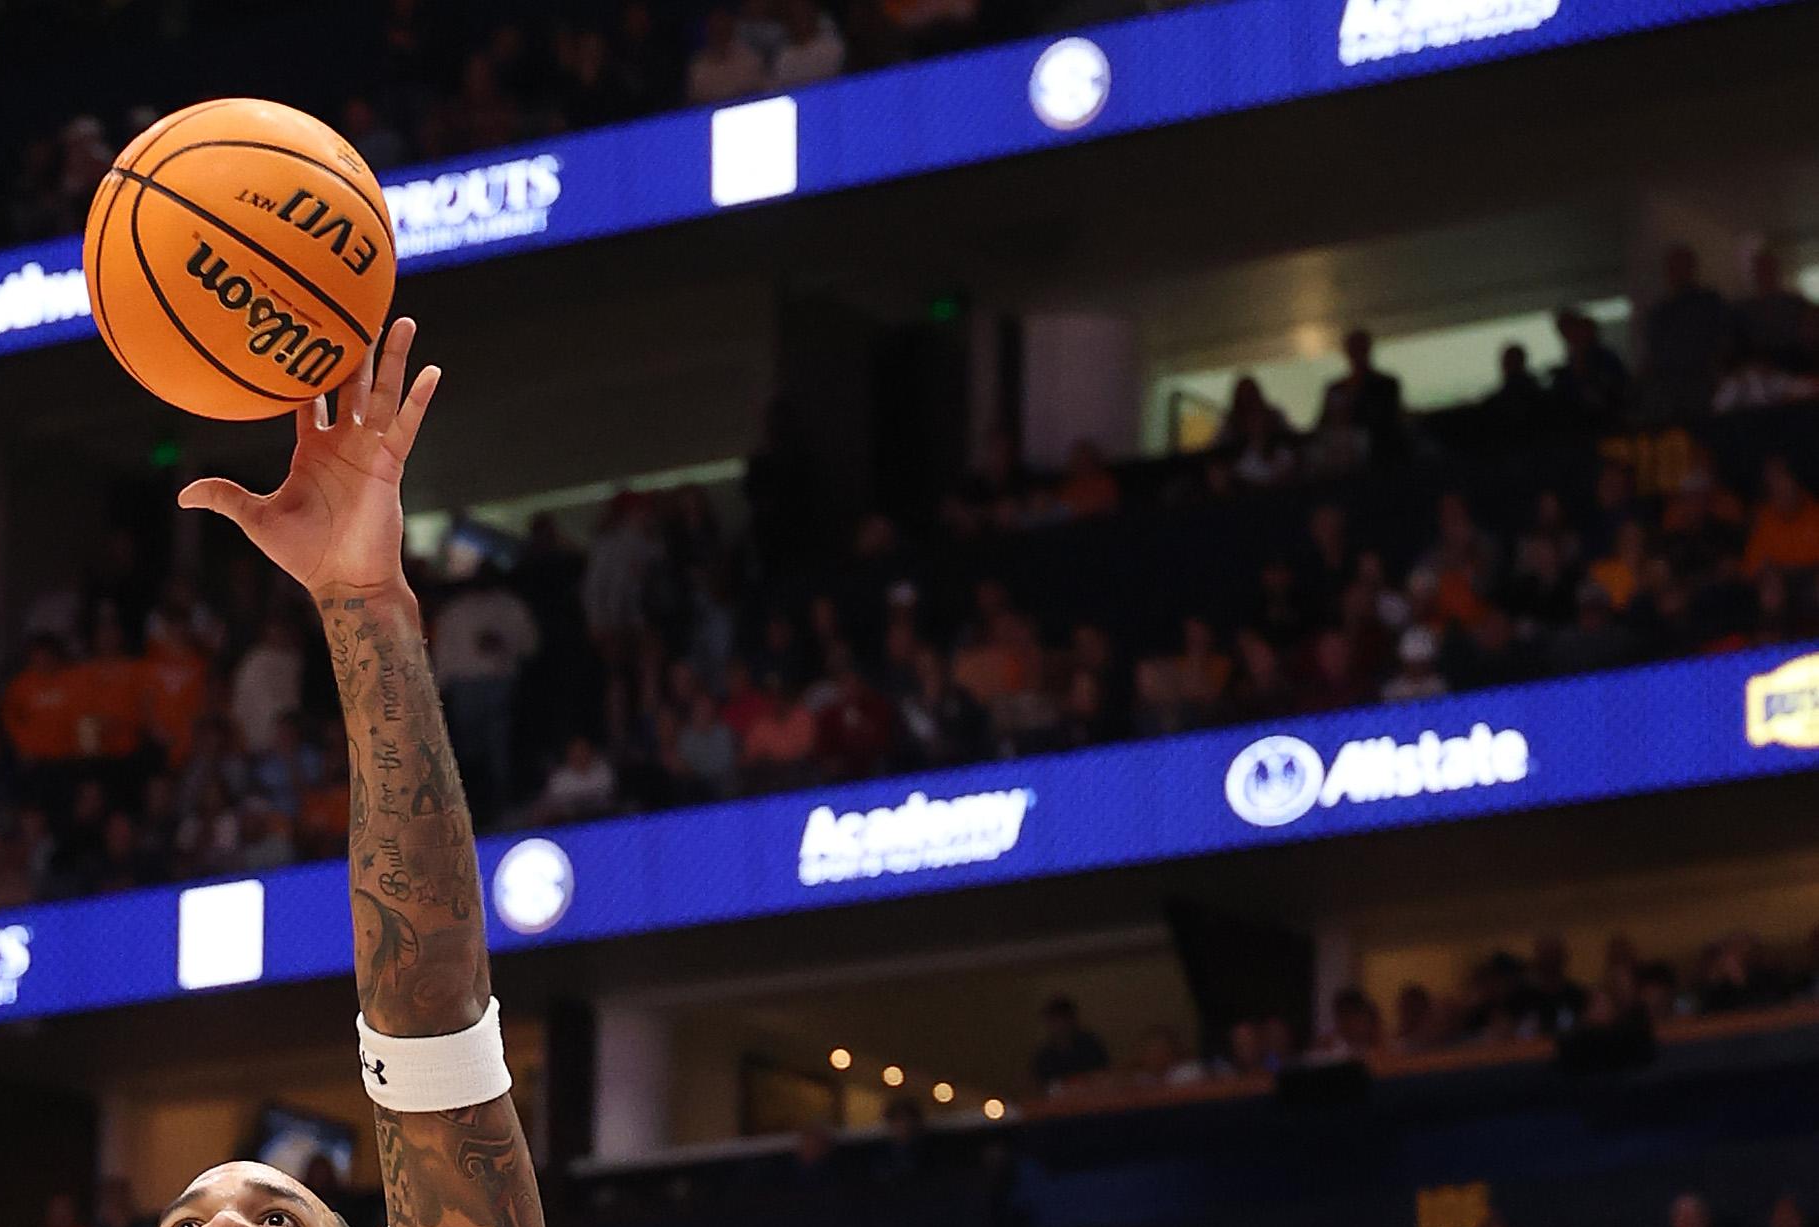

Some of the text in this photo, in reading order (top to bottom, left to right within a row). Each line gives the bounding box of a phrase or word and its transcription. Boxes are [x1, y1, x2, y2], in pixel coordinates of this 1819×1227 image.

[382, 153, 565, 234] PROUTS
[185, 240, 346, 388] Wilson
[375, 738, 403, 774] the
